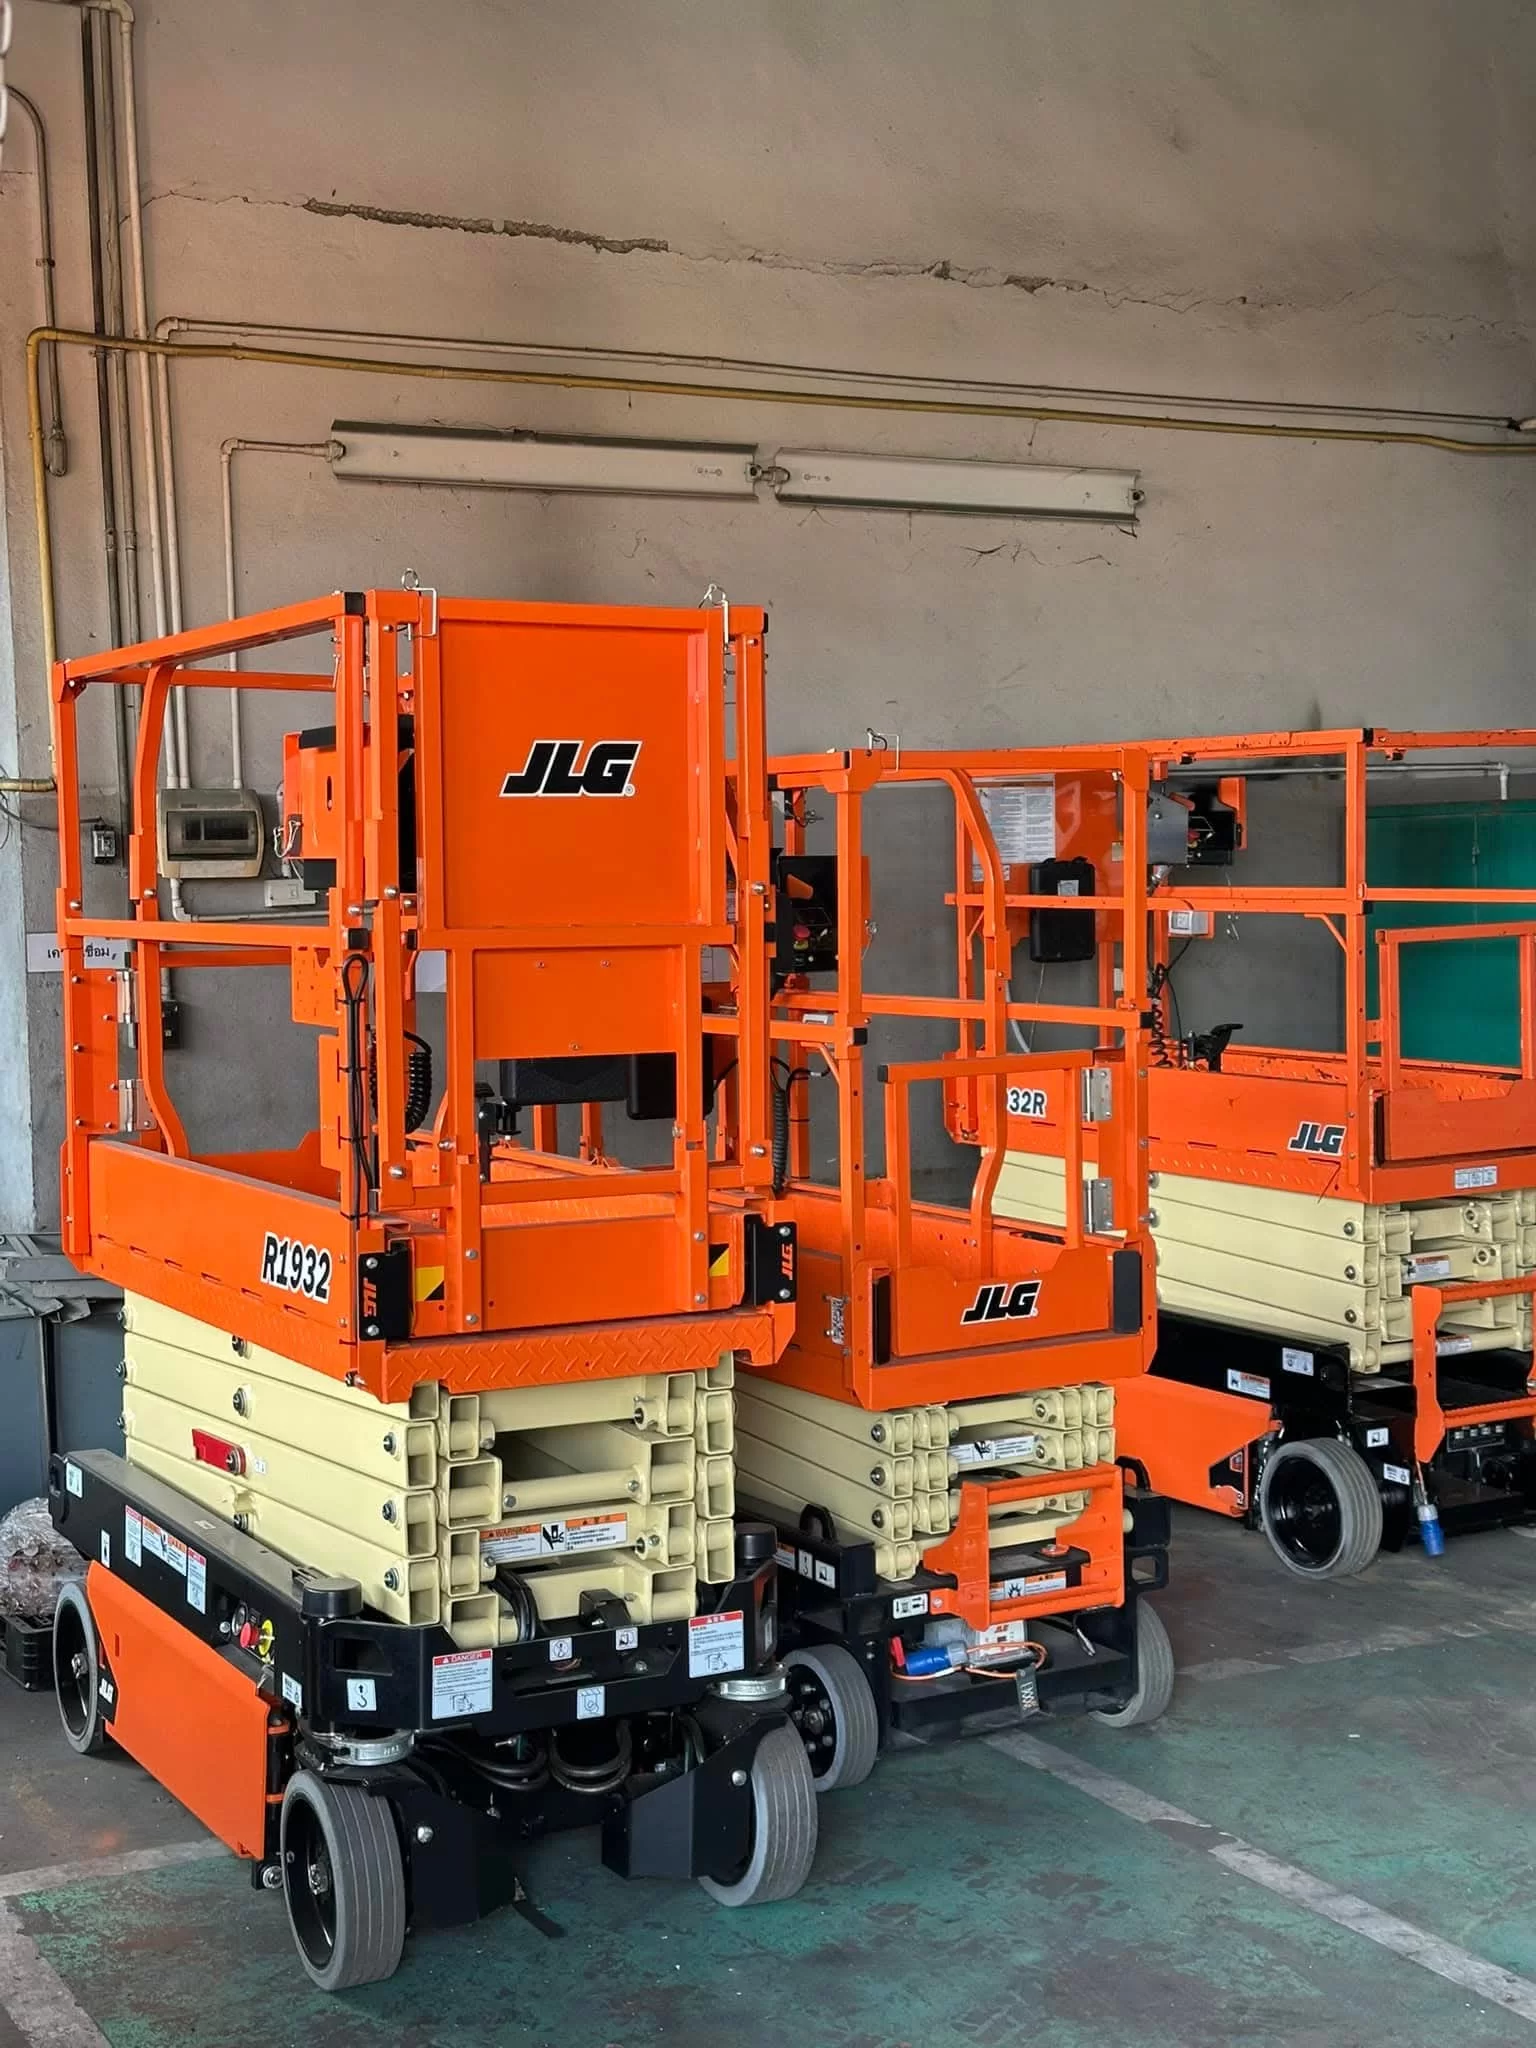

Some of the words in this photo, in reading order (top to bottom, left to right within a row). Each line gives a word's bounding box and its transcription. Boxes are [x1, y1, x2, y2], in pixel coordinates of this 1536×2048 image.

[501, 741, 641, 795] JLG
[1008, 1089, 1046, 1116] 32R
[1288, 1122, 1345, 1155] JLG
[262, 1234, 331, 1301] R1932
[781, 1243, 793, 1280] JLG
[363, 1277, 377, 1317] JLG
[961, 1281, 1041, 1324] JLG
[99, 1678, 114, 1704] JLG
